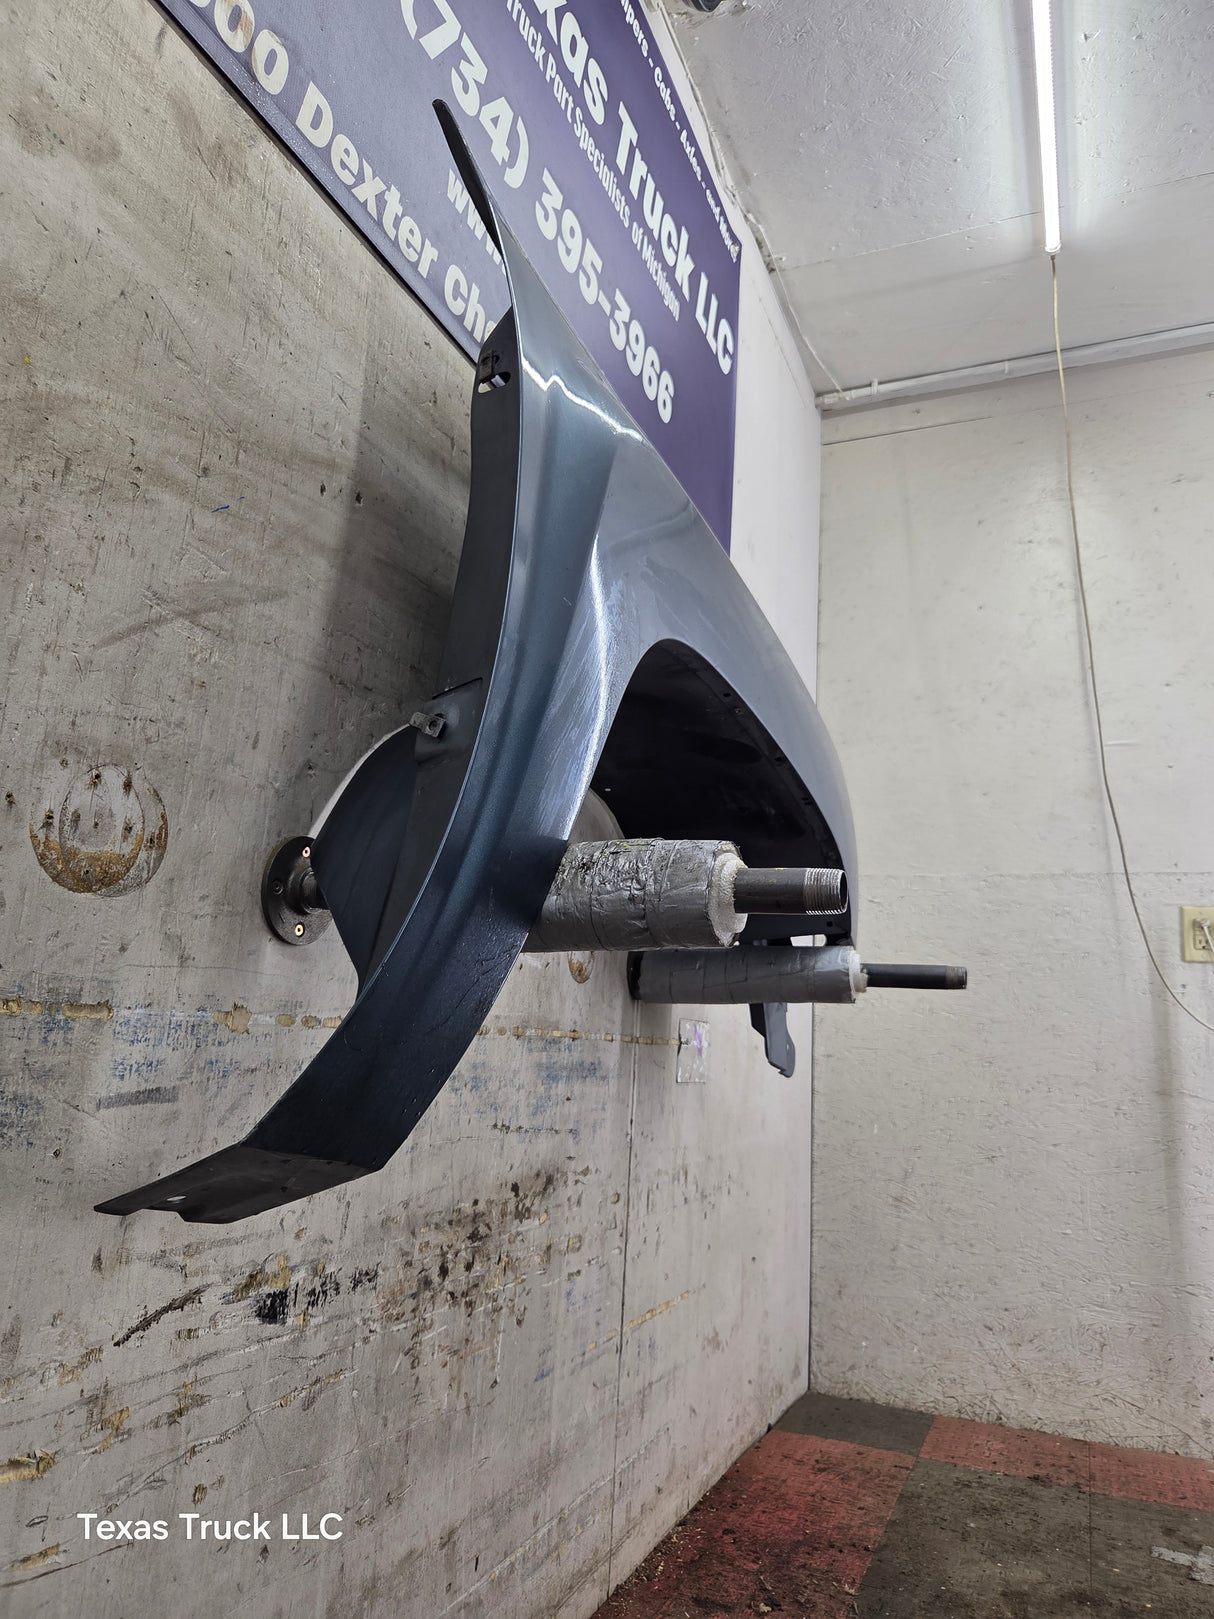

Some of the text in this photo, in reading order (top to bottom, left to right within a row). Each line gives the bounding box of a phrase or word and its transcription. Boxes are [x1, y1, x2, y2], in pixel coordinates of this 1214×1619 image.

[189, 0, 289, 95] 00
[295, 80, 439, 279] Dexter
[545, 52, 575, 124] Part
[573, 106, 631, 229] Specialists
[642, 237, 681, 323] Michigan
[615, 101, 696, 302] Truck
[695, 271, 734, 375] LLC
[535, 167, 675, 424] 395-3966
